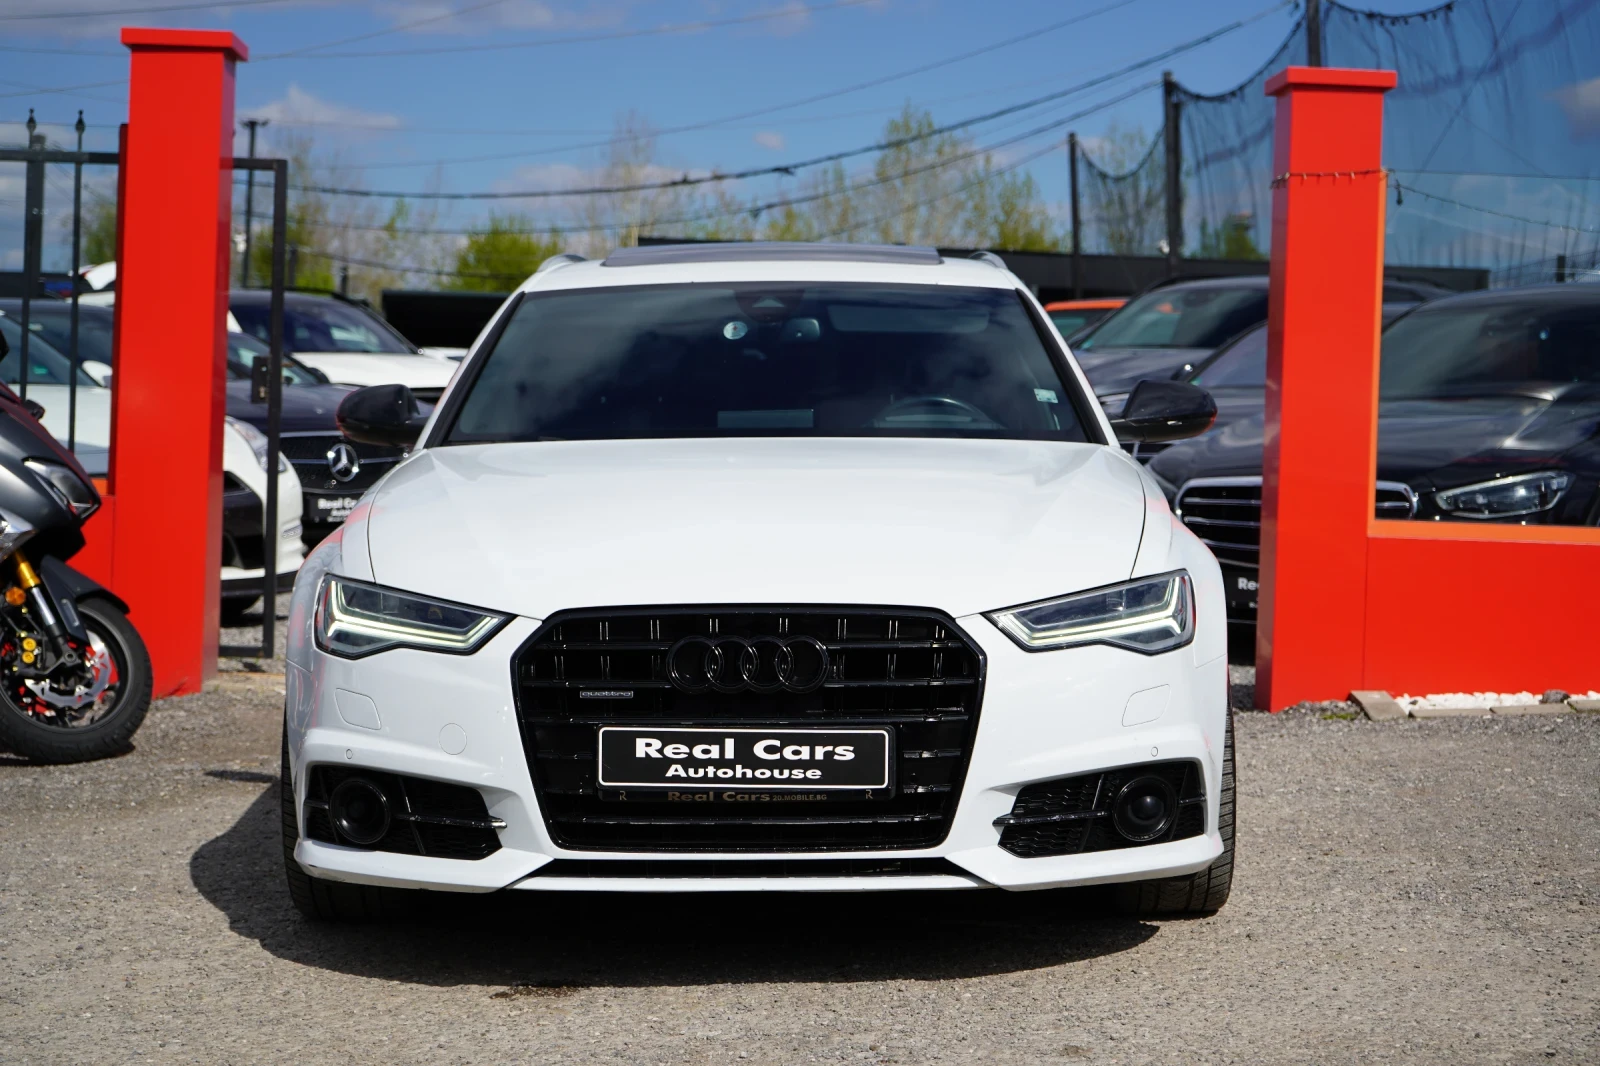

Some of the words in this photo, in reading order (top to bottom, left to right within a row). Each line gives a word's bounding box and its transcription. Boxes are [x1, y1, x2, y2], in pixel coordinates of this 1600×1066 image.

[1237, 577, 1259, 590] Re
[635, 737, 735, 760] Real
[752, 739, 856, 761] Cars
[664, 764, 823, 779] Autohouse
[667, 791, 714, 802] Real
[722, 791, 771, 802] Cars
